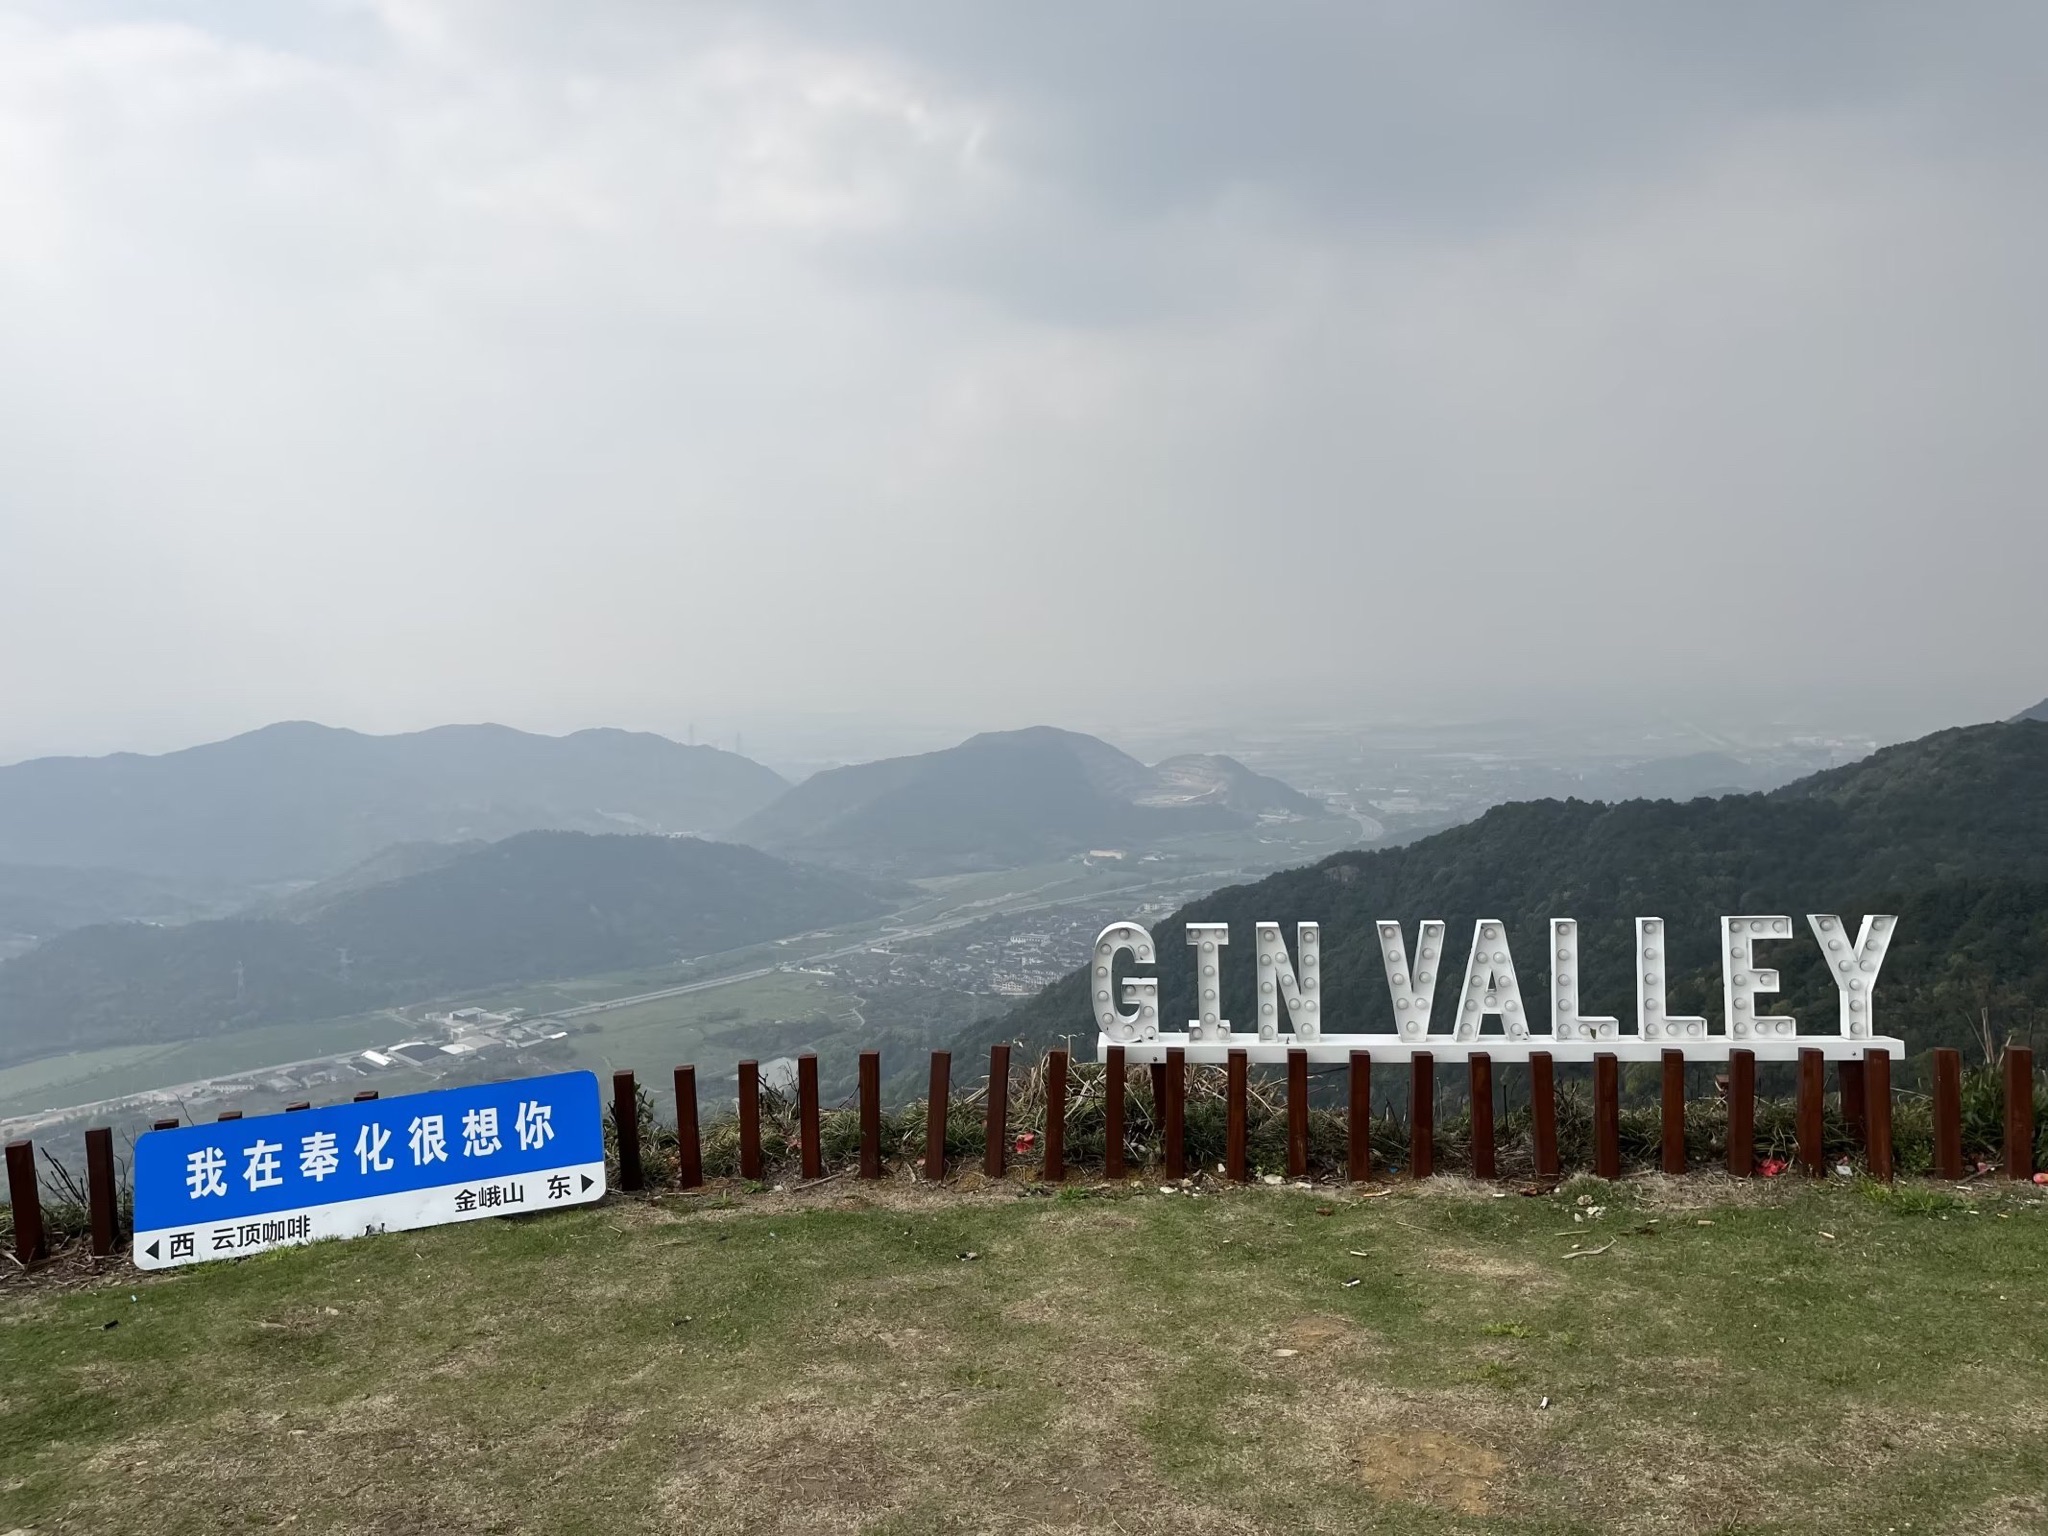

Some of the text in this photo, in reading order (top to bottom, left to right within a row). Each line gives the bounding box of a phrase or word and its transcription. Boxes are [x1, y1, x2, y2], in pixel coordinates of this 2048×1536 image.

[1092, 915, 1899, 1042] GIN VALLEY
[186, 1100, 555, 1200] 我在奉化很想你
[454, 1174, 572, 1213] 金峨山 东
[169, 1214, 311, 1260] 西 云顶咖啡
